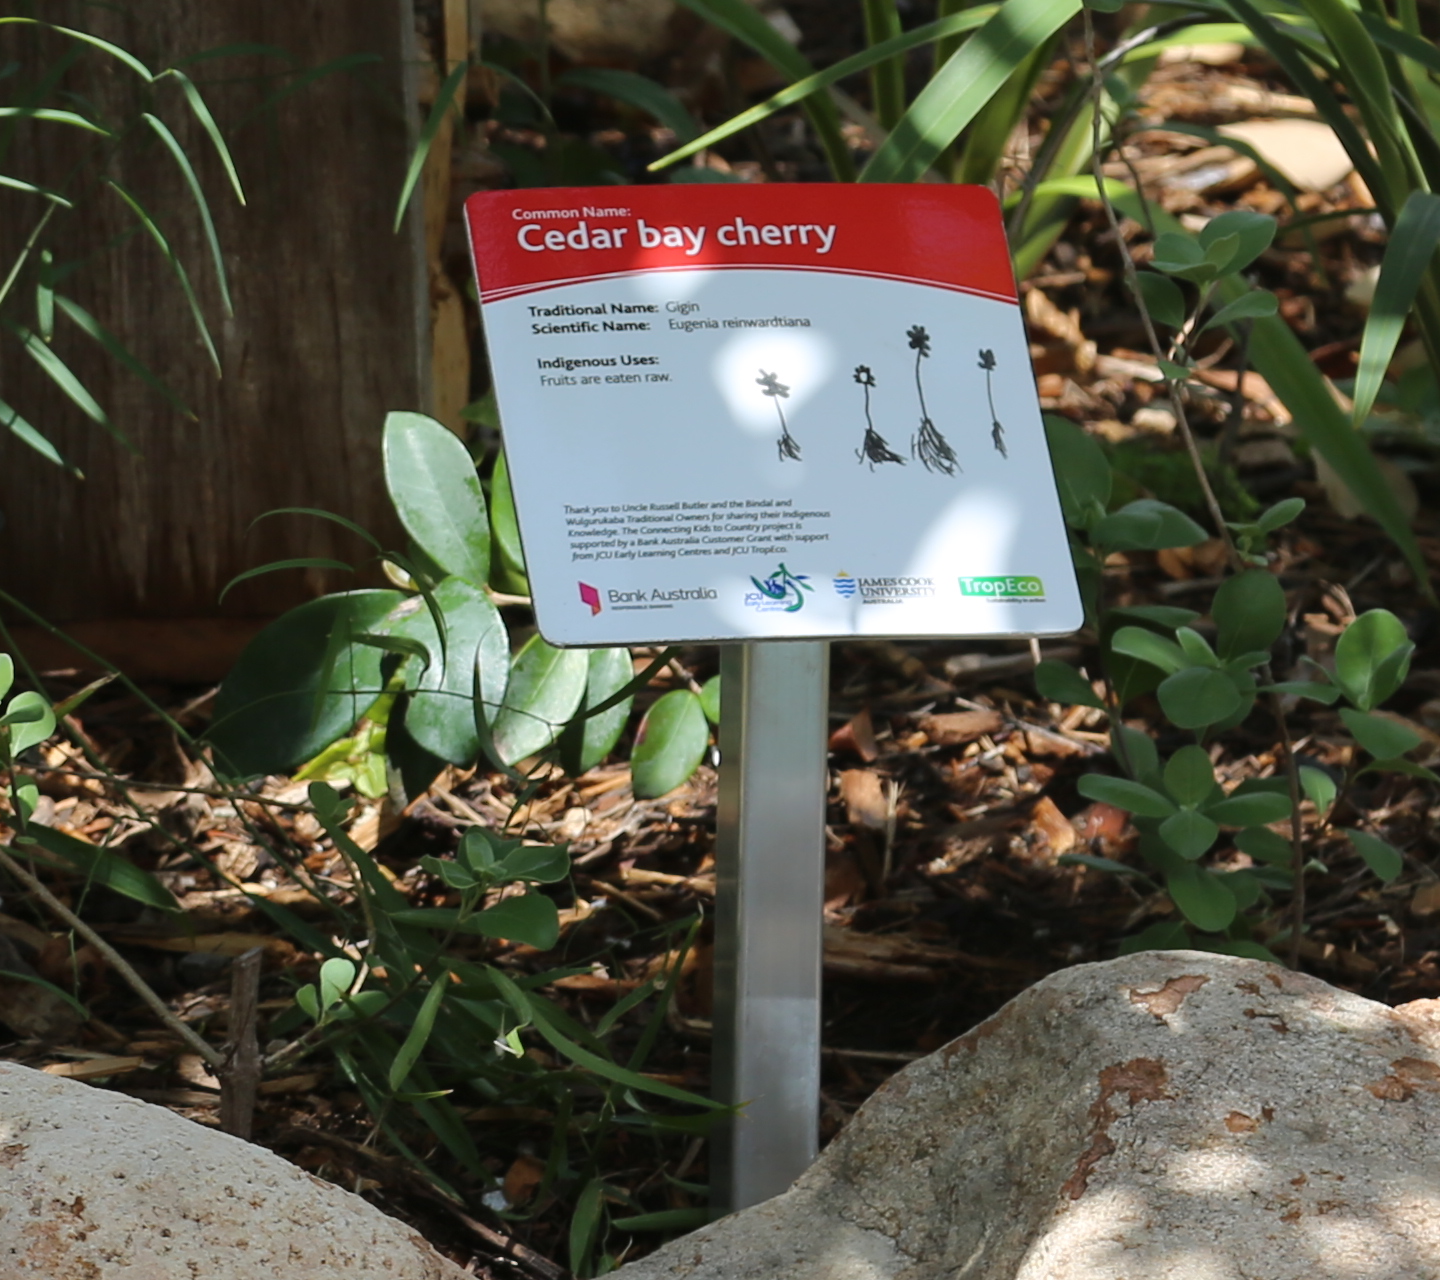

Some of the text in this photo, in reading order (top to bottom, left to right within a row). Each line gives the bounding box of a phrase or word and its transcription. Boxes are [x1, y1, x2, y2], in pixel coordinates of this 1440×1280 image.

[511, 206, 632, 220] Common Name:
[517, 217, 836, 255] Cedar bay cherry
[528, 301, 700, 317] Traditional Name: Gigin
[531, 316, 811, 335] Scientific Name: Eugenia reinwardtiana
[537, 355, 660, 371] Indigenous Uses:
[540, 373, 673, 387] Fruits are eaten raw.
[564, 498, 792, 515] Thank you to Uncle Russell Butler and the Bindal and
[627, 514, 674, 523] Traditional
[675, 513, 710, 521] Owners
[711, 512, 724, 522] for
[726, 511, 758, 521] sharing
[760, 510, 781, 519] their
[783, 510, 831, 520] Indigenous
[622, 527, 638, 535] The
[640, 525, 692, 535] Connecting
[693, 524, 711, 533] Kids
[713, 524, 723, 532] to
[724, 523, 761, 533] Country
[761, 522, 794, 532] project
[795, 521, 802, 530] is
[570, 539, 615, 550] supported
[617, 539, 628, 548] by
[637, 538, 658, 546] Bank
[661, 536, 700, 545] Australia
[701, 535, 745, 544] Customer
[746, 534, 772, 542] Grant
[773, 533, 794, 541] with
[795, 532, 829, 542] support
[572, 552, 594, 561] from
[595, 551, 613, 561] JCU
[614, 550, 636, 560] Early
[638, 549, 676, 559] Learning
[677, 547, 712, 556] Centres
[713, 546, 731, 555] and
[731, 546, 749, 556] JCU
[858, 577, 936, 587] JAMES COOK
[960, 578, 1040, 597] TropEco
[608, 587, 718, 603] Bank Australia
[860, 587, 936, 596] UNIVERSITY
